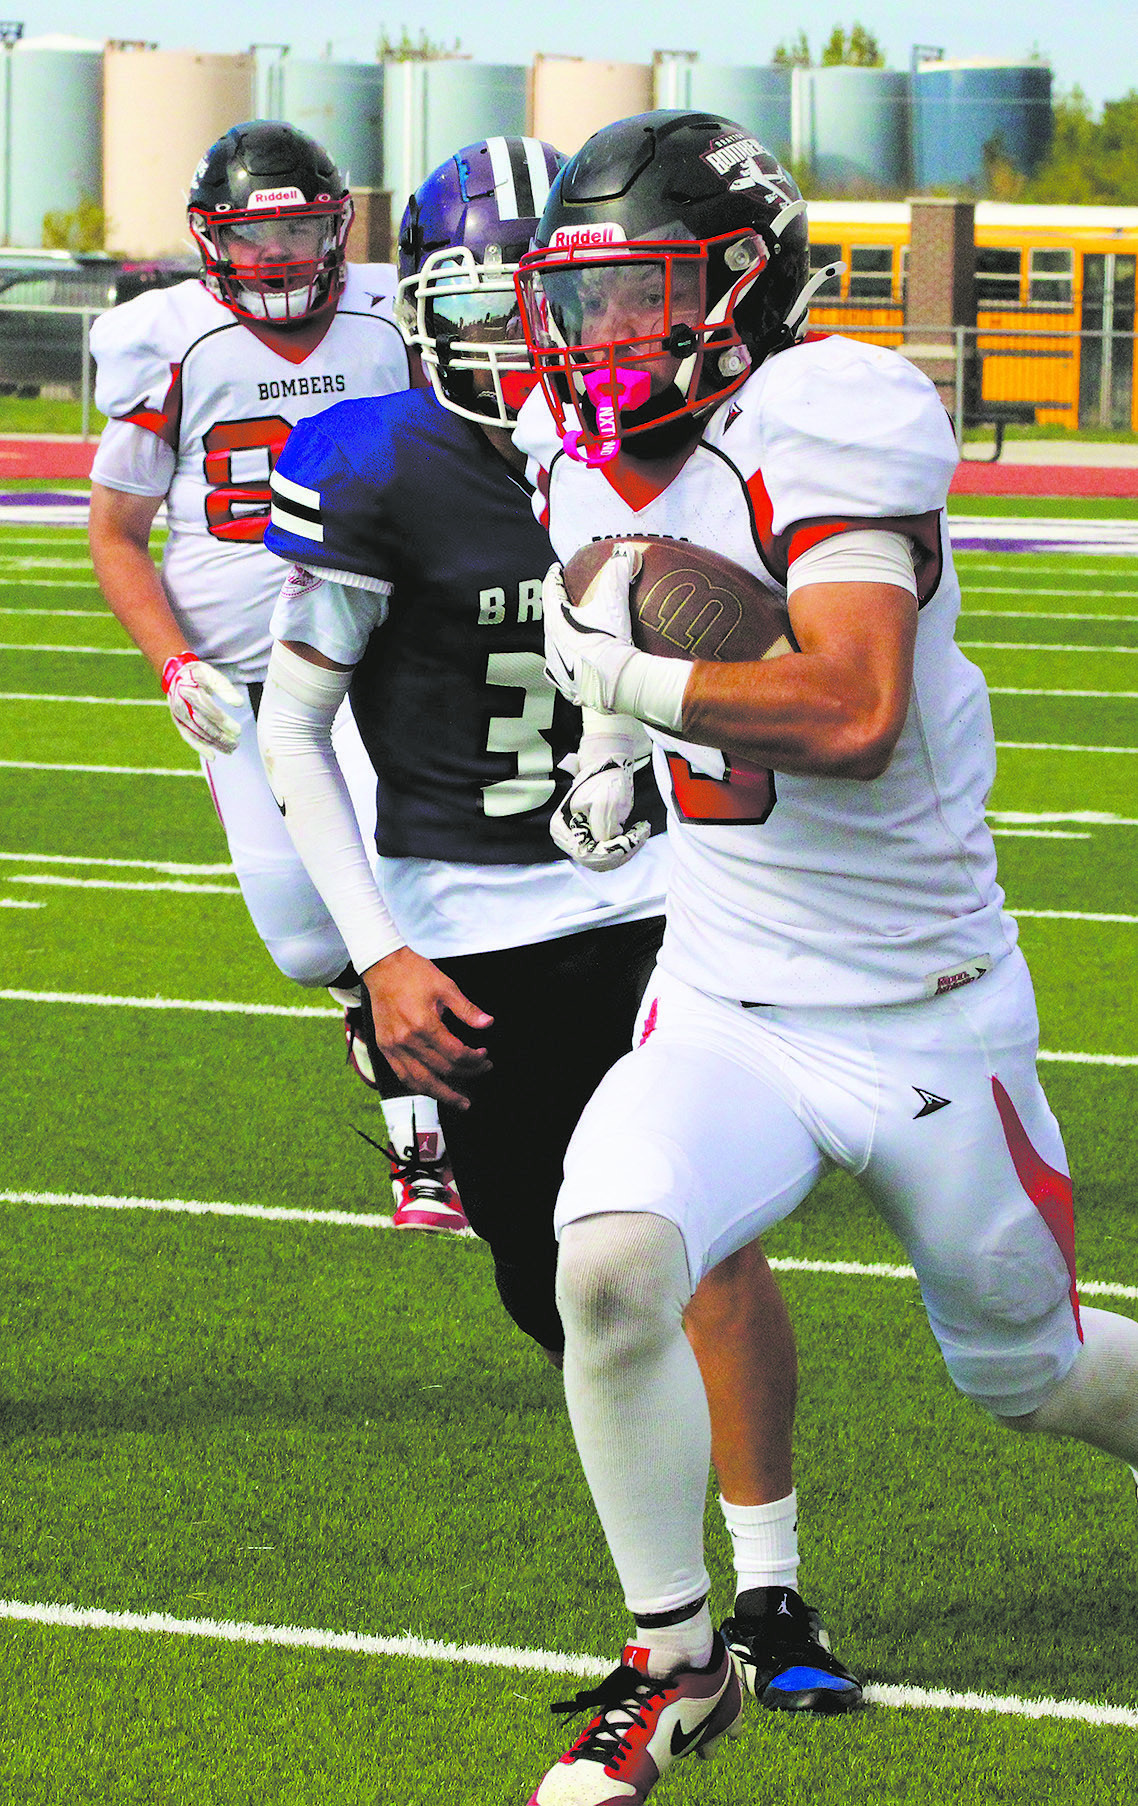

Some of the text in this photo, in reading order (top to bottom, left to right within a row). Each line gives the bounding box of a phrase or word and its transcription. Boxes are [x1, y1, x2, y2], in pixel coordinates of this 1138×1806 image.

[255, 190, 297, 203] Riddell
[556, 228, 614, 247] Riddell
[258, 375, 345, 400] BOMBERS
[598, 406, 617, 456] NXTND
[478, 579, 543, 625] BR
